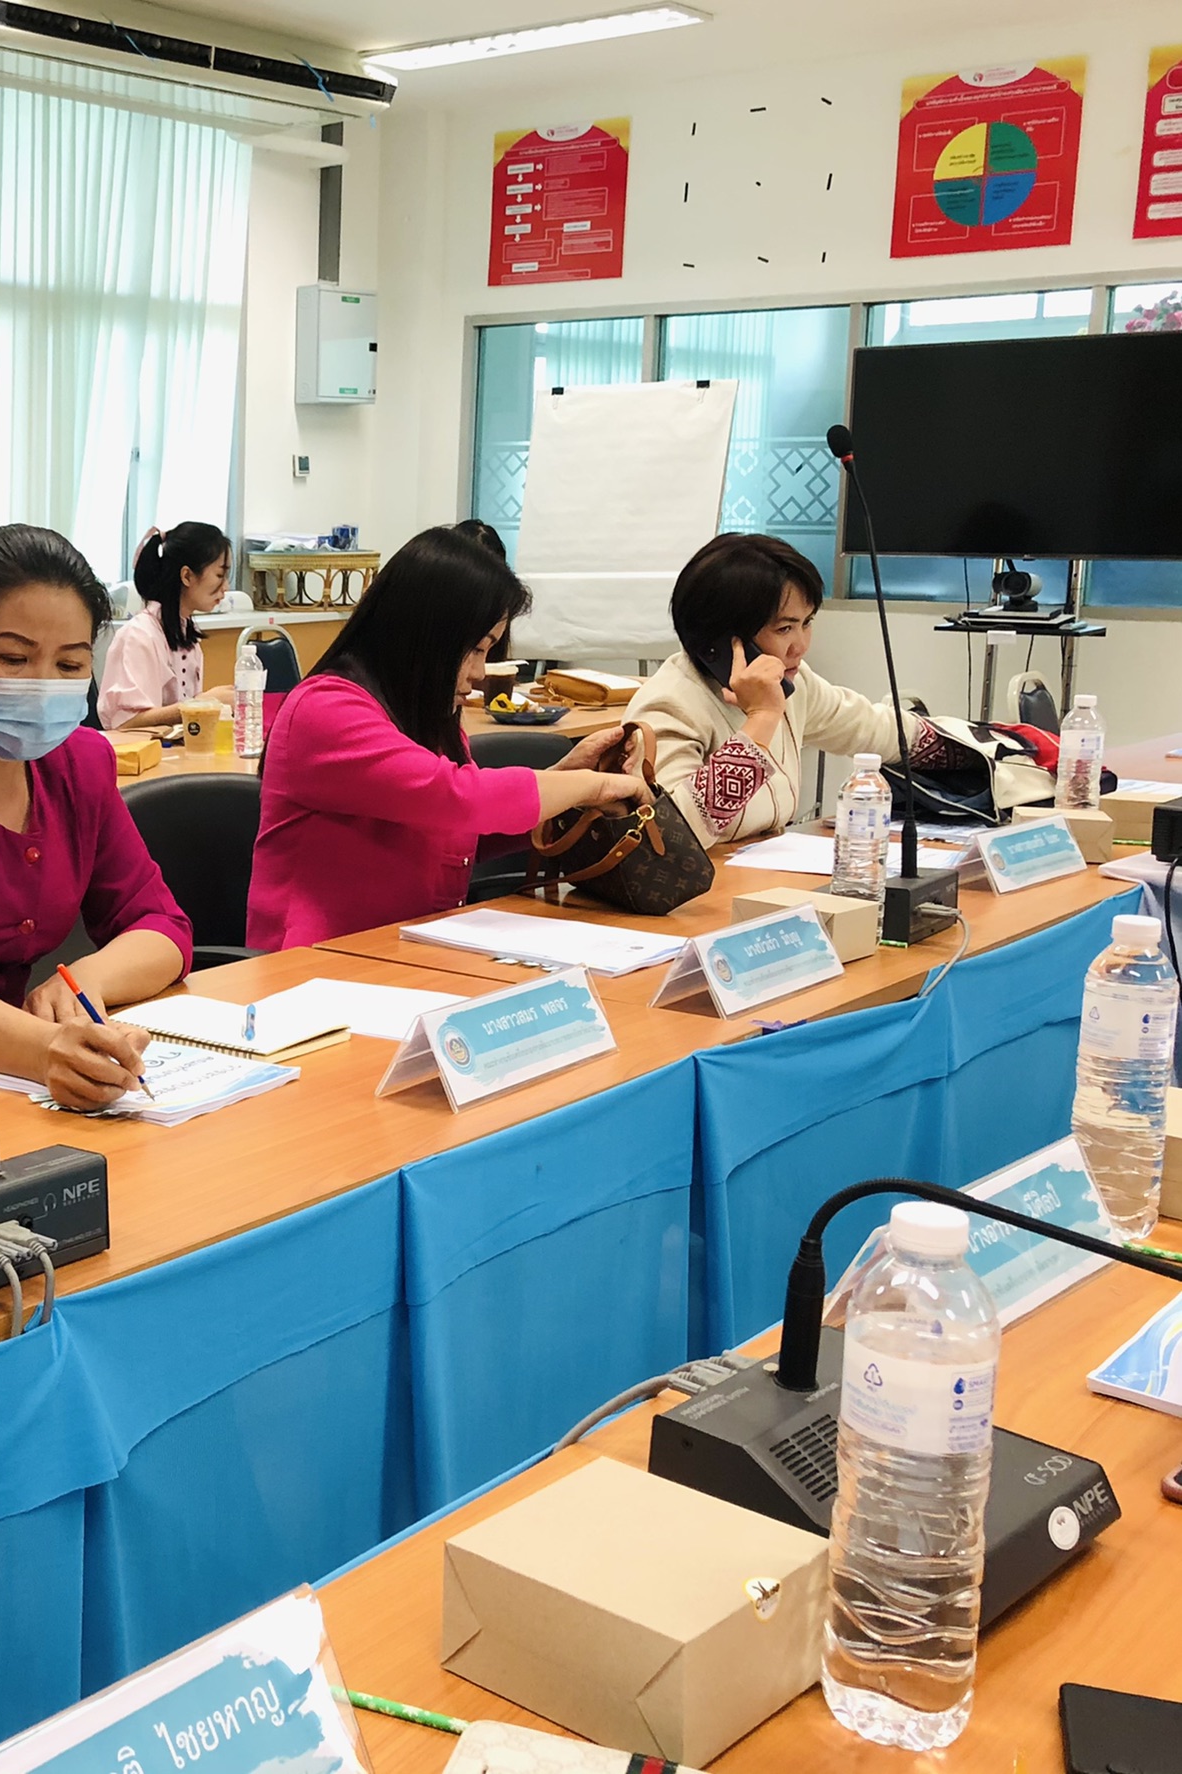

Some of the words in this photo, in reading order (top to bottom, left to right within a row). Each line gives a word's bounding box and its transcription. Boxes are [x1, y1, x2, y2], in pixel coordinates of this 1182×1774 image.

[62, 1178, 100, 1202] NPE
[1072, 1481, 1109, 1520] NPE
[153, 1679, 286, 1770] ไชยหาญ
